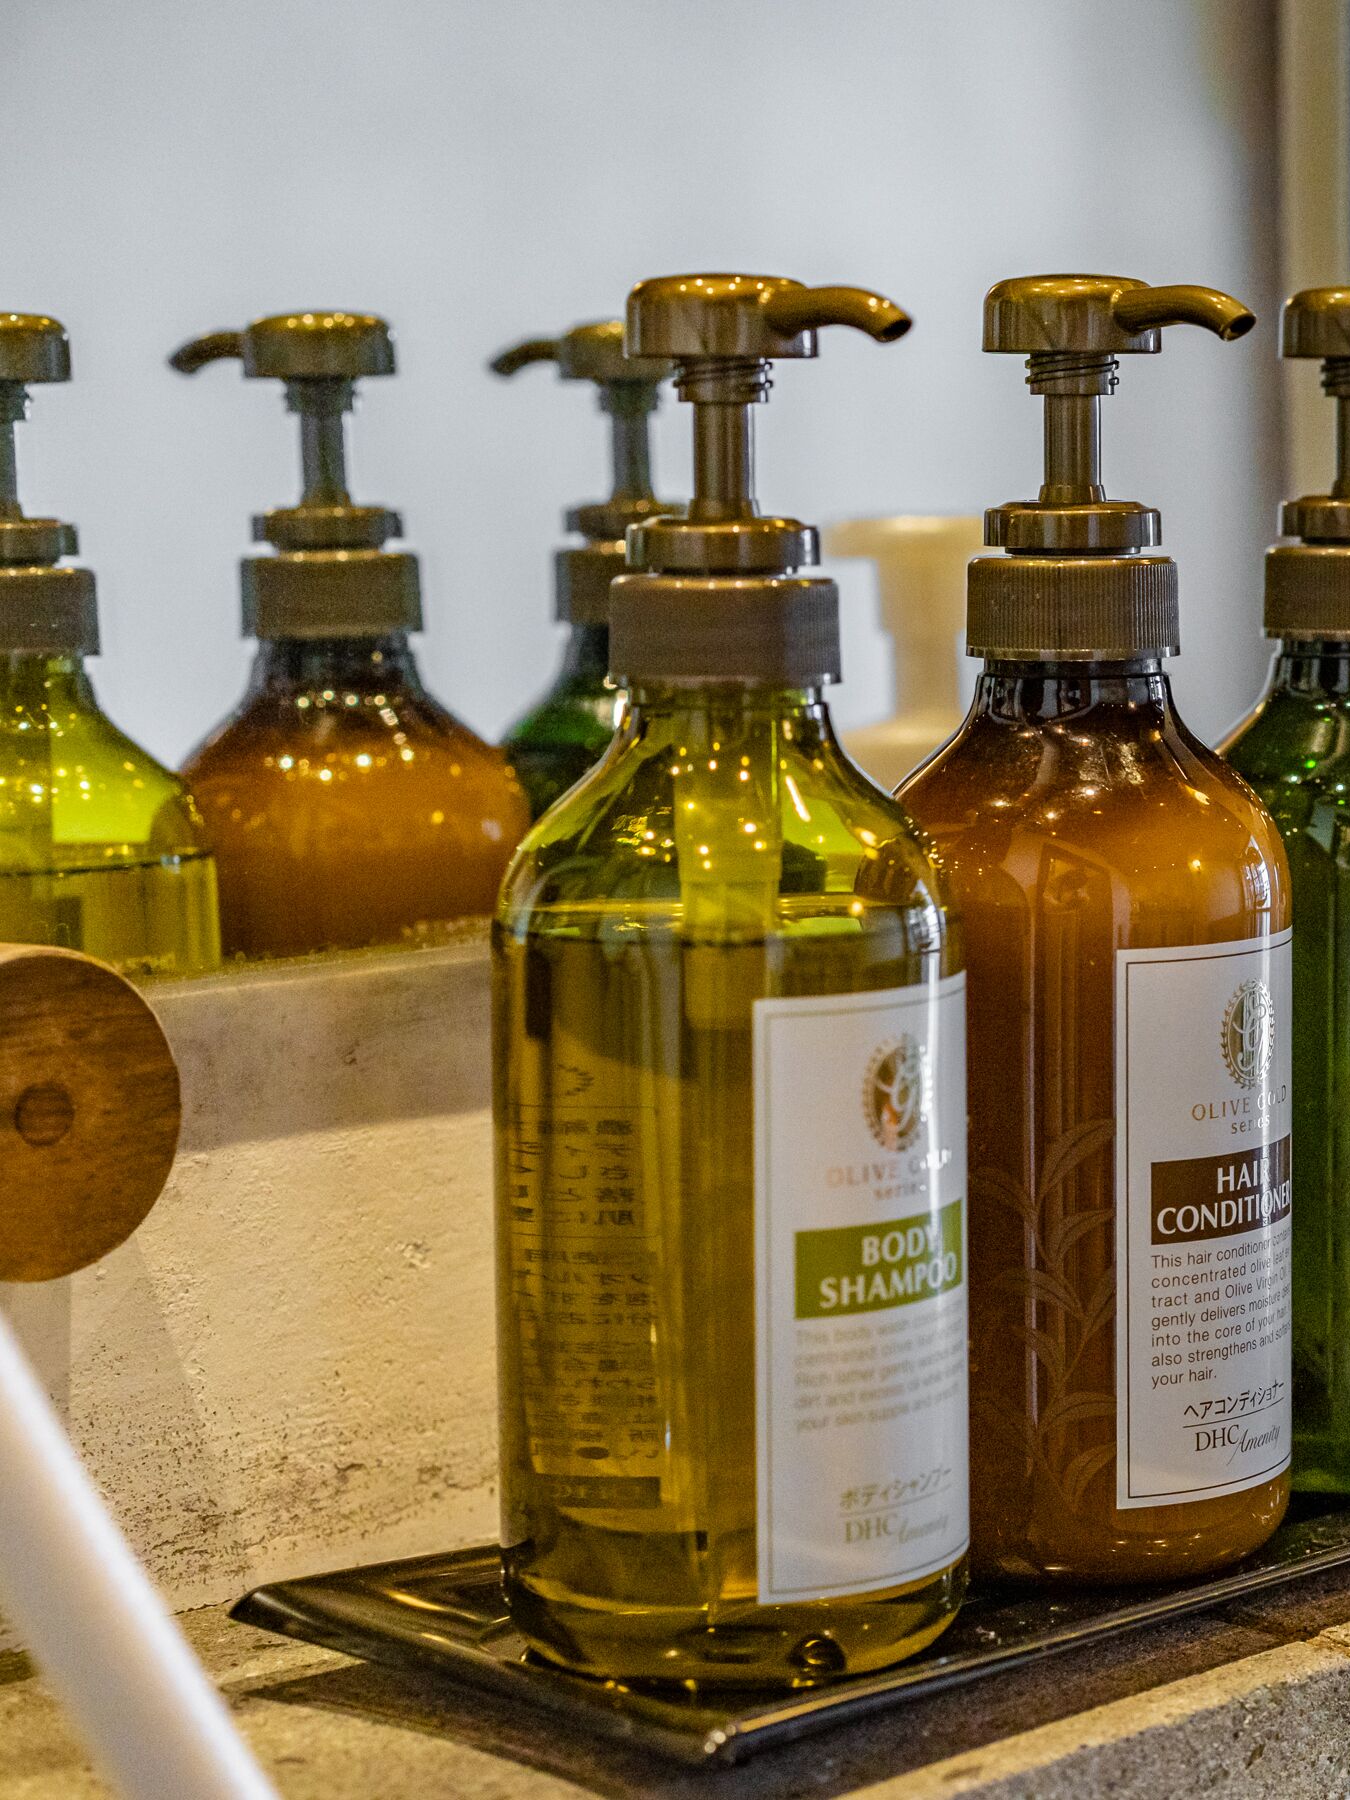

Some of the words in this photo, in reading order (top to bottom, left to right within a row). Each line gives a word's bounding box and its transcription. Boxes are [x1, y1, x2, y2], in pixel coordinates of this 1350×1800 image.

[1192, 1097, 1250, 1121] OLIVE
[1231, 1115, 1270, 1134] series
[1217, 1159, 1271, 1194] HAIR
[1157, 1180, 1290, 1234] CONDITIONER
[862, 1223, 942, 1266] BODY
[1152, 1254, 1182, 1269] This
[1188, 1250, 1212, 1265] hair
[1217, 1239, 1270, 1262] conditioner
[820, 1252, 957, 1308] SHAMPOO
[1152, 1262, 1246, 1288] concentrated
[1251, 1257, 1270, 1273] olive
[1152, 1292, 1187, 1308] tract
[1194, 1287, 1220, 1303] and
[1225, 1282, 1252, 1298] Olive
[1152, 1311, 1196, 1331] gently
[1200, 1304, 1245, 1323] delivers
[1249, 1291, 1281, 1312] moisture
[1152, 1334, 1181, 1347] into
[1187, 1329, 1210, 1343] the
[1215, 1324, 1241, 1340] core
[1246, 1317, 1256, 1332] of
[1258, 1312, 1275, 1332] your
[1152, 1353, 1182, 1367] also
[1188, 1339, 1257, 1363] strengthens
[1260, 1331, 1274, 1346] and
[1152, 1374, 1184, 1389] your
[1189, 1366, 1217, 1382] hair.
[1184, 1379, 1284, 1419] ヘアコンディショナー
[1195, 1424, 1239, 1452] DHC
[1226, 1424, 1280, 1466] Amenity
[843, 1513, 897, 1545] DHC
